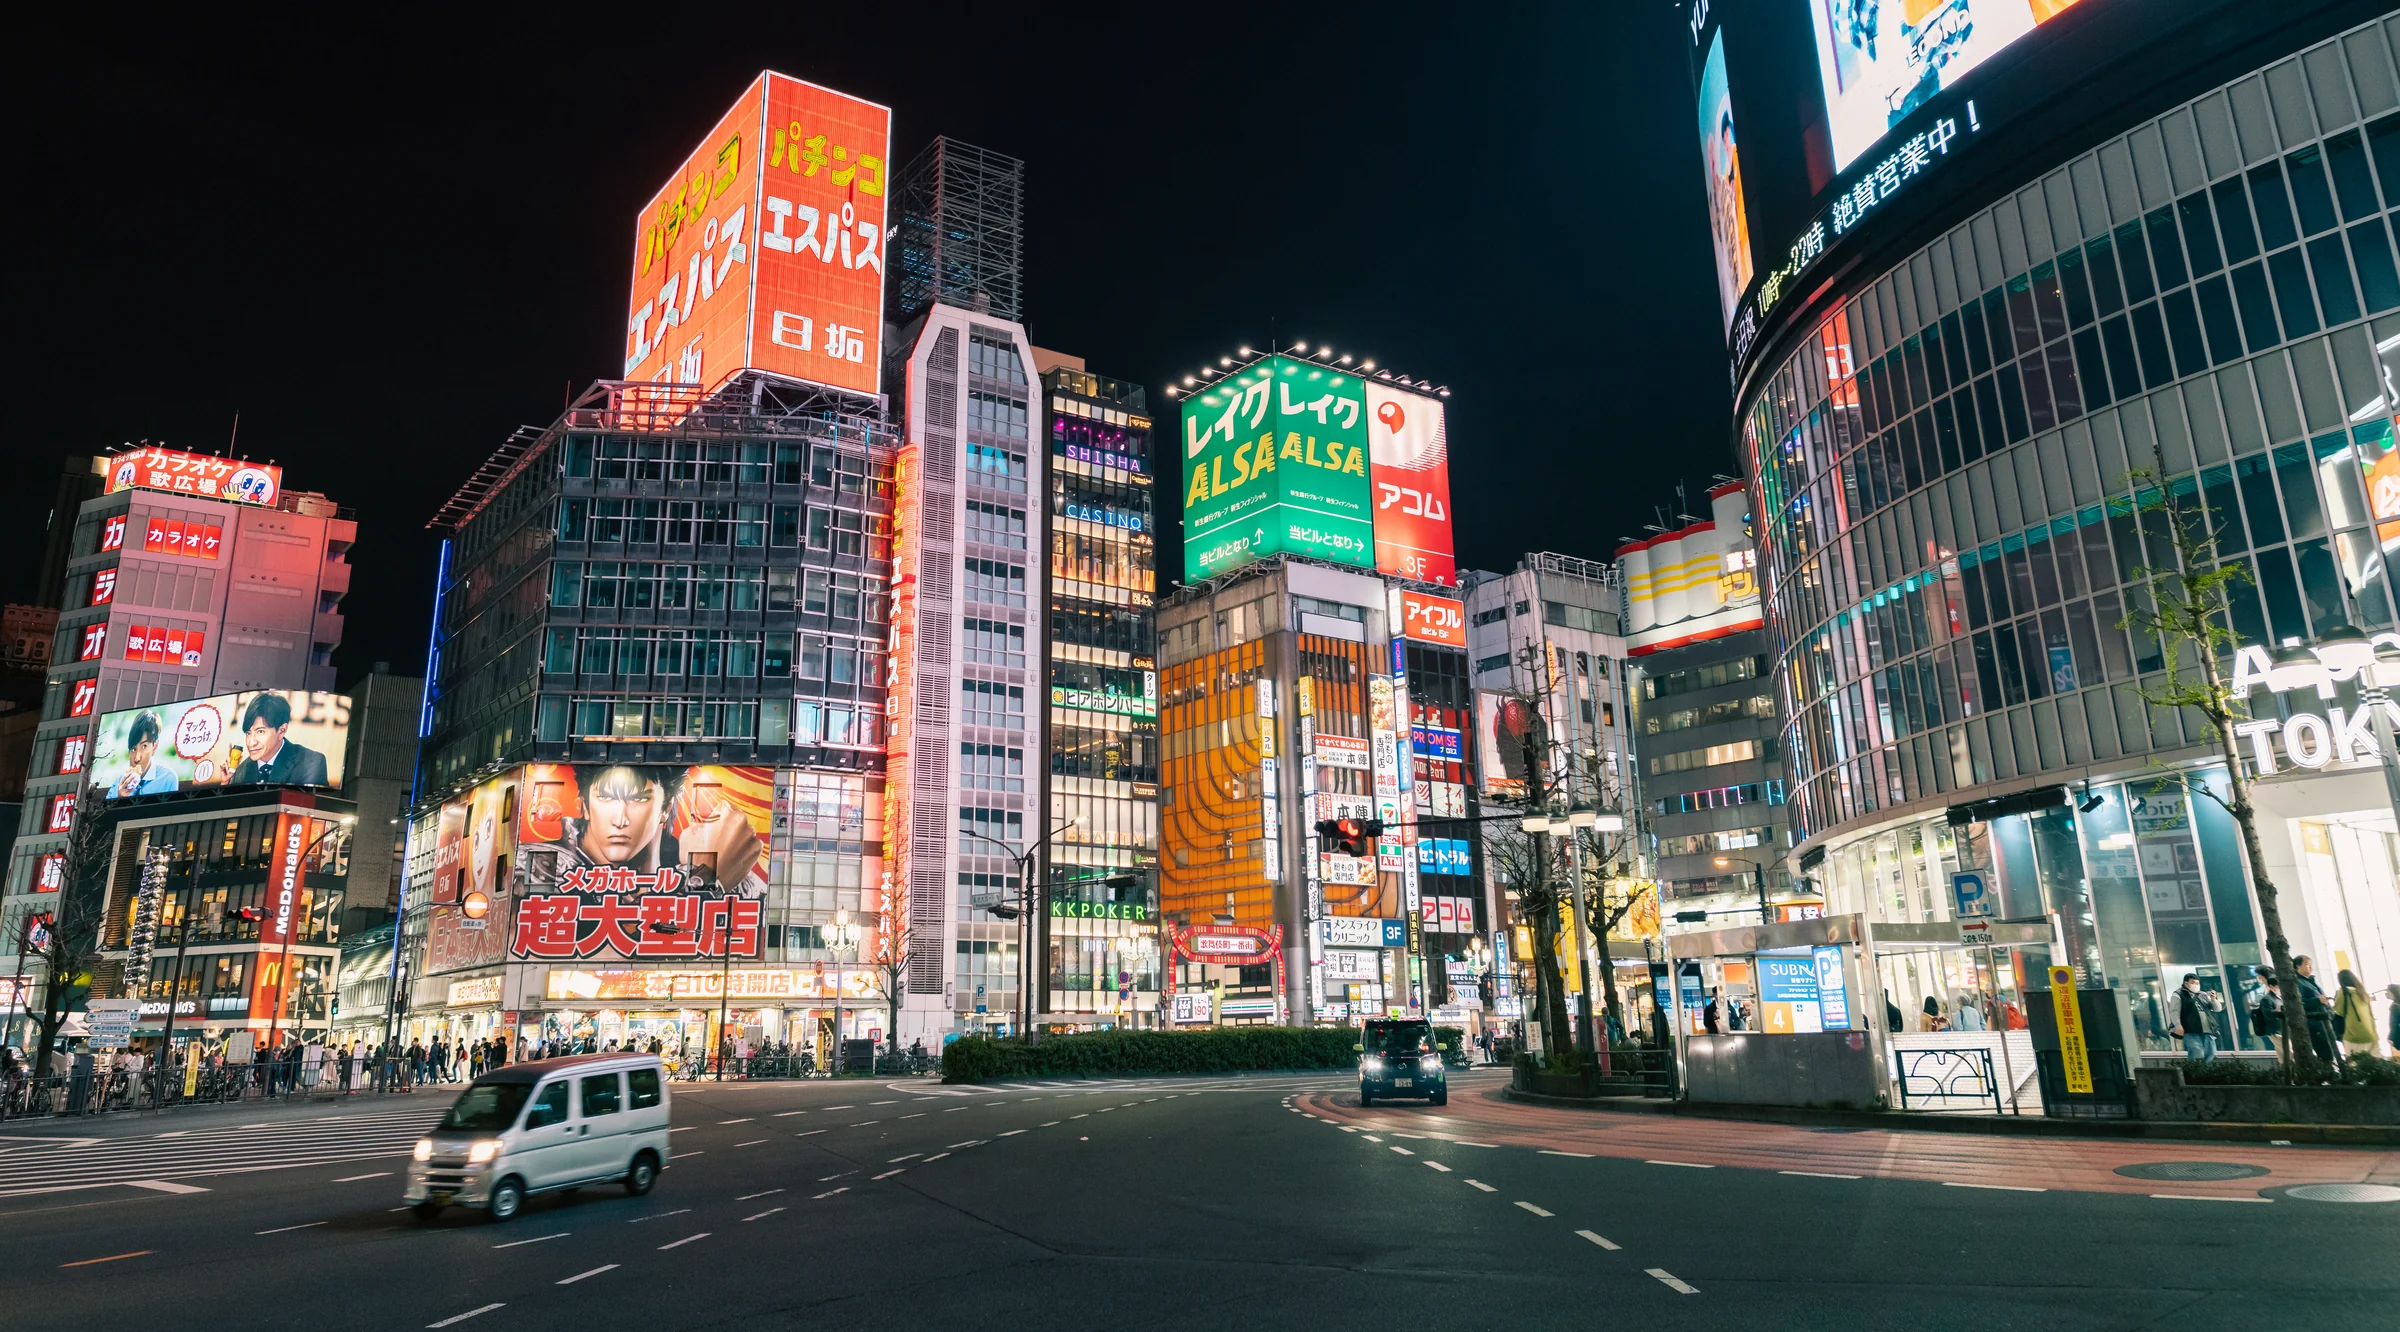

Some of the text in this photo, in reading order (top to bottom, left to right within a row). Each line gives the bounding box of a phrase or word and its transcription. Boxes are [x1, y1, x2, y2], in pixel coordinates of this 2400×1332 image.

[769, 121, 884, 196] パチンコ
[642, 132, 740, 278] パチンコ
[763, 196, 881, 275] エスパス
[626, 203, 746, 376] エスパス
[1188, 378, 1270, 459] レイク
[1280, 382, 1360, 430] レイク
[146, 451, 233, 478] カラオケ
[1068, 445, 1140, 472] SHISHA
[1280, 432, 1364, 476] ALSA
[1186, 431, 1276, 508] ALSA
[149, 472, 218, 496] 歌広場
[893, 458, 906, 550] パチンコ
[1378, 481, 1446, 522] アコム
[1067, 504, 1142, 532] CASINO
[148, 528, 220, 550] カラオケ
[1289, 524, 1352, 550] 当ビルとなり
[1200, 536, 1250, 566] 当ビルとなり
[1406, 556, 1426, 574] 3F
[888, 556, 902, 684] エスパス
[1406, 601, 1462, 629] アイフル
[1620, 586, 1631, 632] Quijote
[129, 636, 182, 654] 歌広場
[1438, 629, 1450, 638] 5F
[1347, 753, 1368, 766] 本陣
[1376, 738, 1386, 768] 専門店
[1385, 734, 1394, 764] 粉もの
[1377, 774, 1396, 787] 本陣
[1337, 803, 1369, 820] 本陣
[1066, 828, 1144, 846] BEAUTY
[1382, 835, 1400, 844] たばこ
[437, 836, 460, 869] エスパス
[1382, 856, 1402, 866] ATM
[1419, 848, 1469, 866] セントラル
[276, 824, 302, 934] McDonald's
[559, 866, 682, 894] メガホール
[878, 783, 896, 959] パチンコ エスパス
[1334, 862, 1354, 872] 粉もの
[1334, 872, 1354, 882] 専門店
[1954, 874, 1984, 914] P
[1052, 901, 1146, 920] KKPOKER
[1422, 902, 1472, 921] アコム
[512, 895, 760, 957] 超大型店
[1333, 920, 1378, 932] メンズライフ
[1333, 932, 1370, 944] クリニック
[1386, 926, 1402, 940] 3F
[1200, 939, 1253, 951] 歌舞伎町一番街
[1449, 961, 1465, 970] BUY
[1770, 963, 1816, 978] SUBN
[1819, 957, 1832, 986] P
[649, 972, 790, 994] 本日10時開店
[977, 986, 984, 998] P
[1194, 1005, 1206, 1016] 190
[1774, 1008, 1785, 1028] 4
[2059, 986, 2076, 1034] 違法駐車禁止
